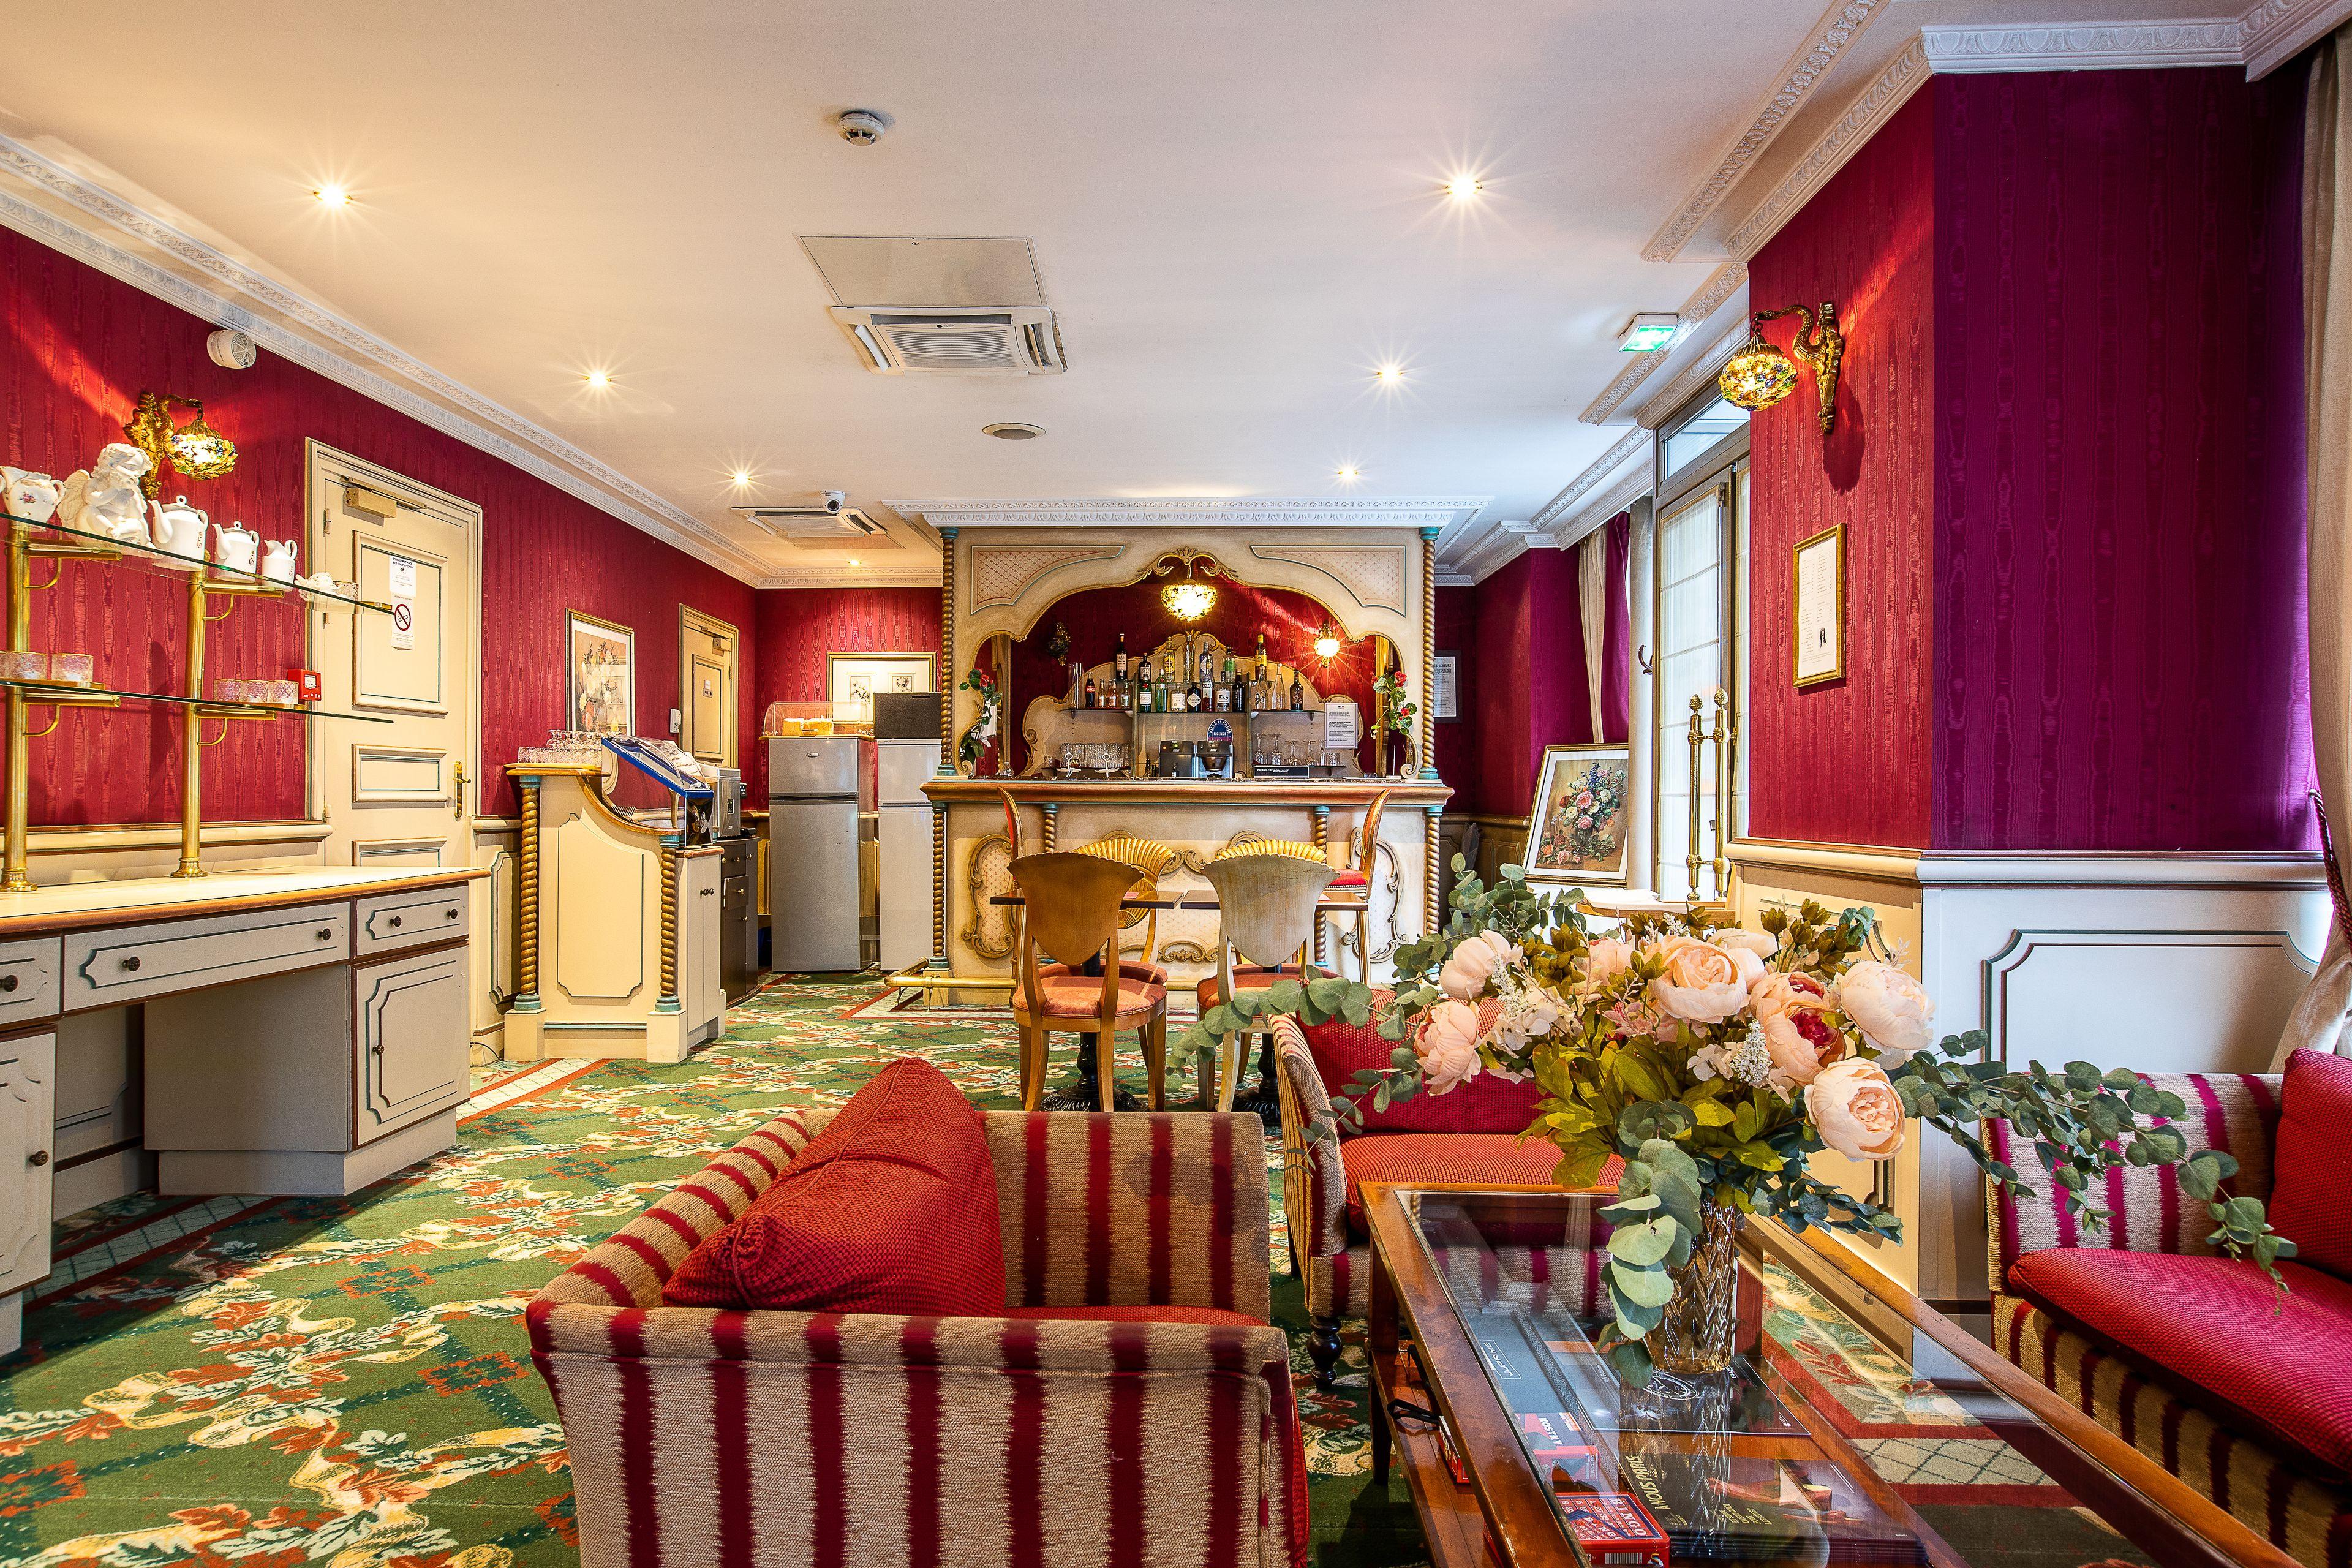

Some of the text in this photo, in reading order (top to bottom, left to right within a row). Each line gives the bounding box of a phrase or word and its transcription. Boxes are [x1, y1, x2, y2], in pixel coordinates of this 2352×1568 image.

[1208, 721, 1218, 734] VILLE
[1222, 721, 1232, 734] PARIS
[1538, 1417, 1564, 1446] KOSTKY
[1625, 1455, 1650, 1481] PARIS
[1640, 1482, 1665, 1506] NOUS
[1611, 1498, 1647, 1536] BINGO
